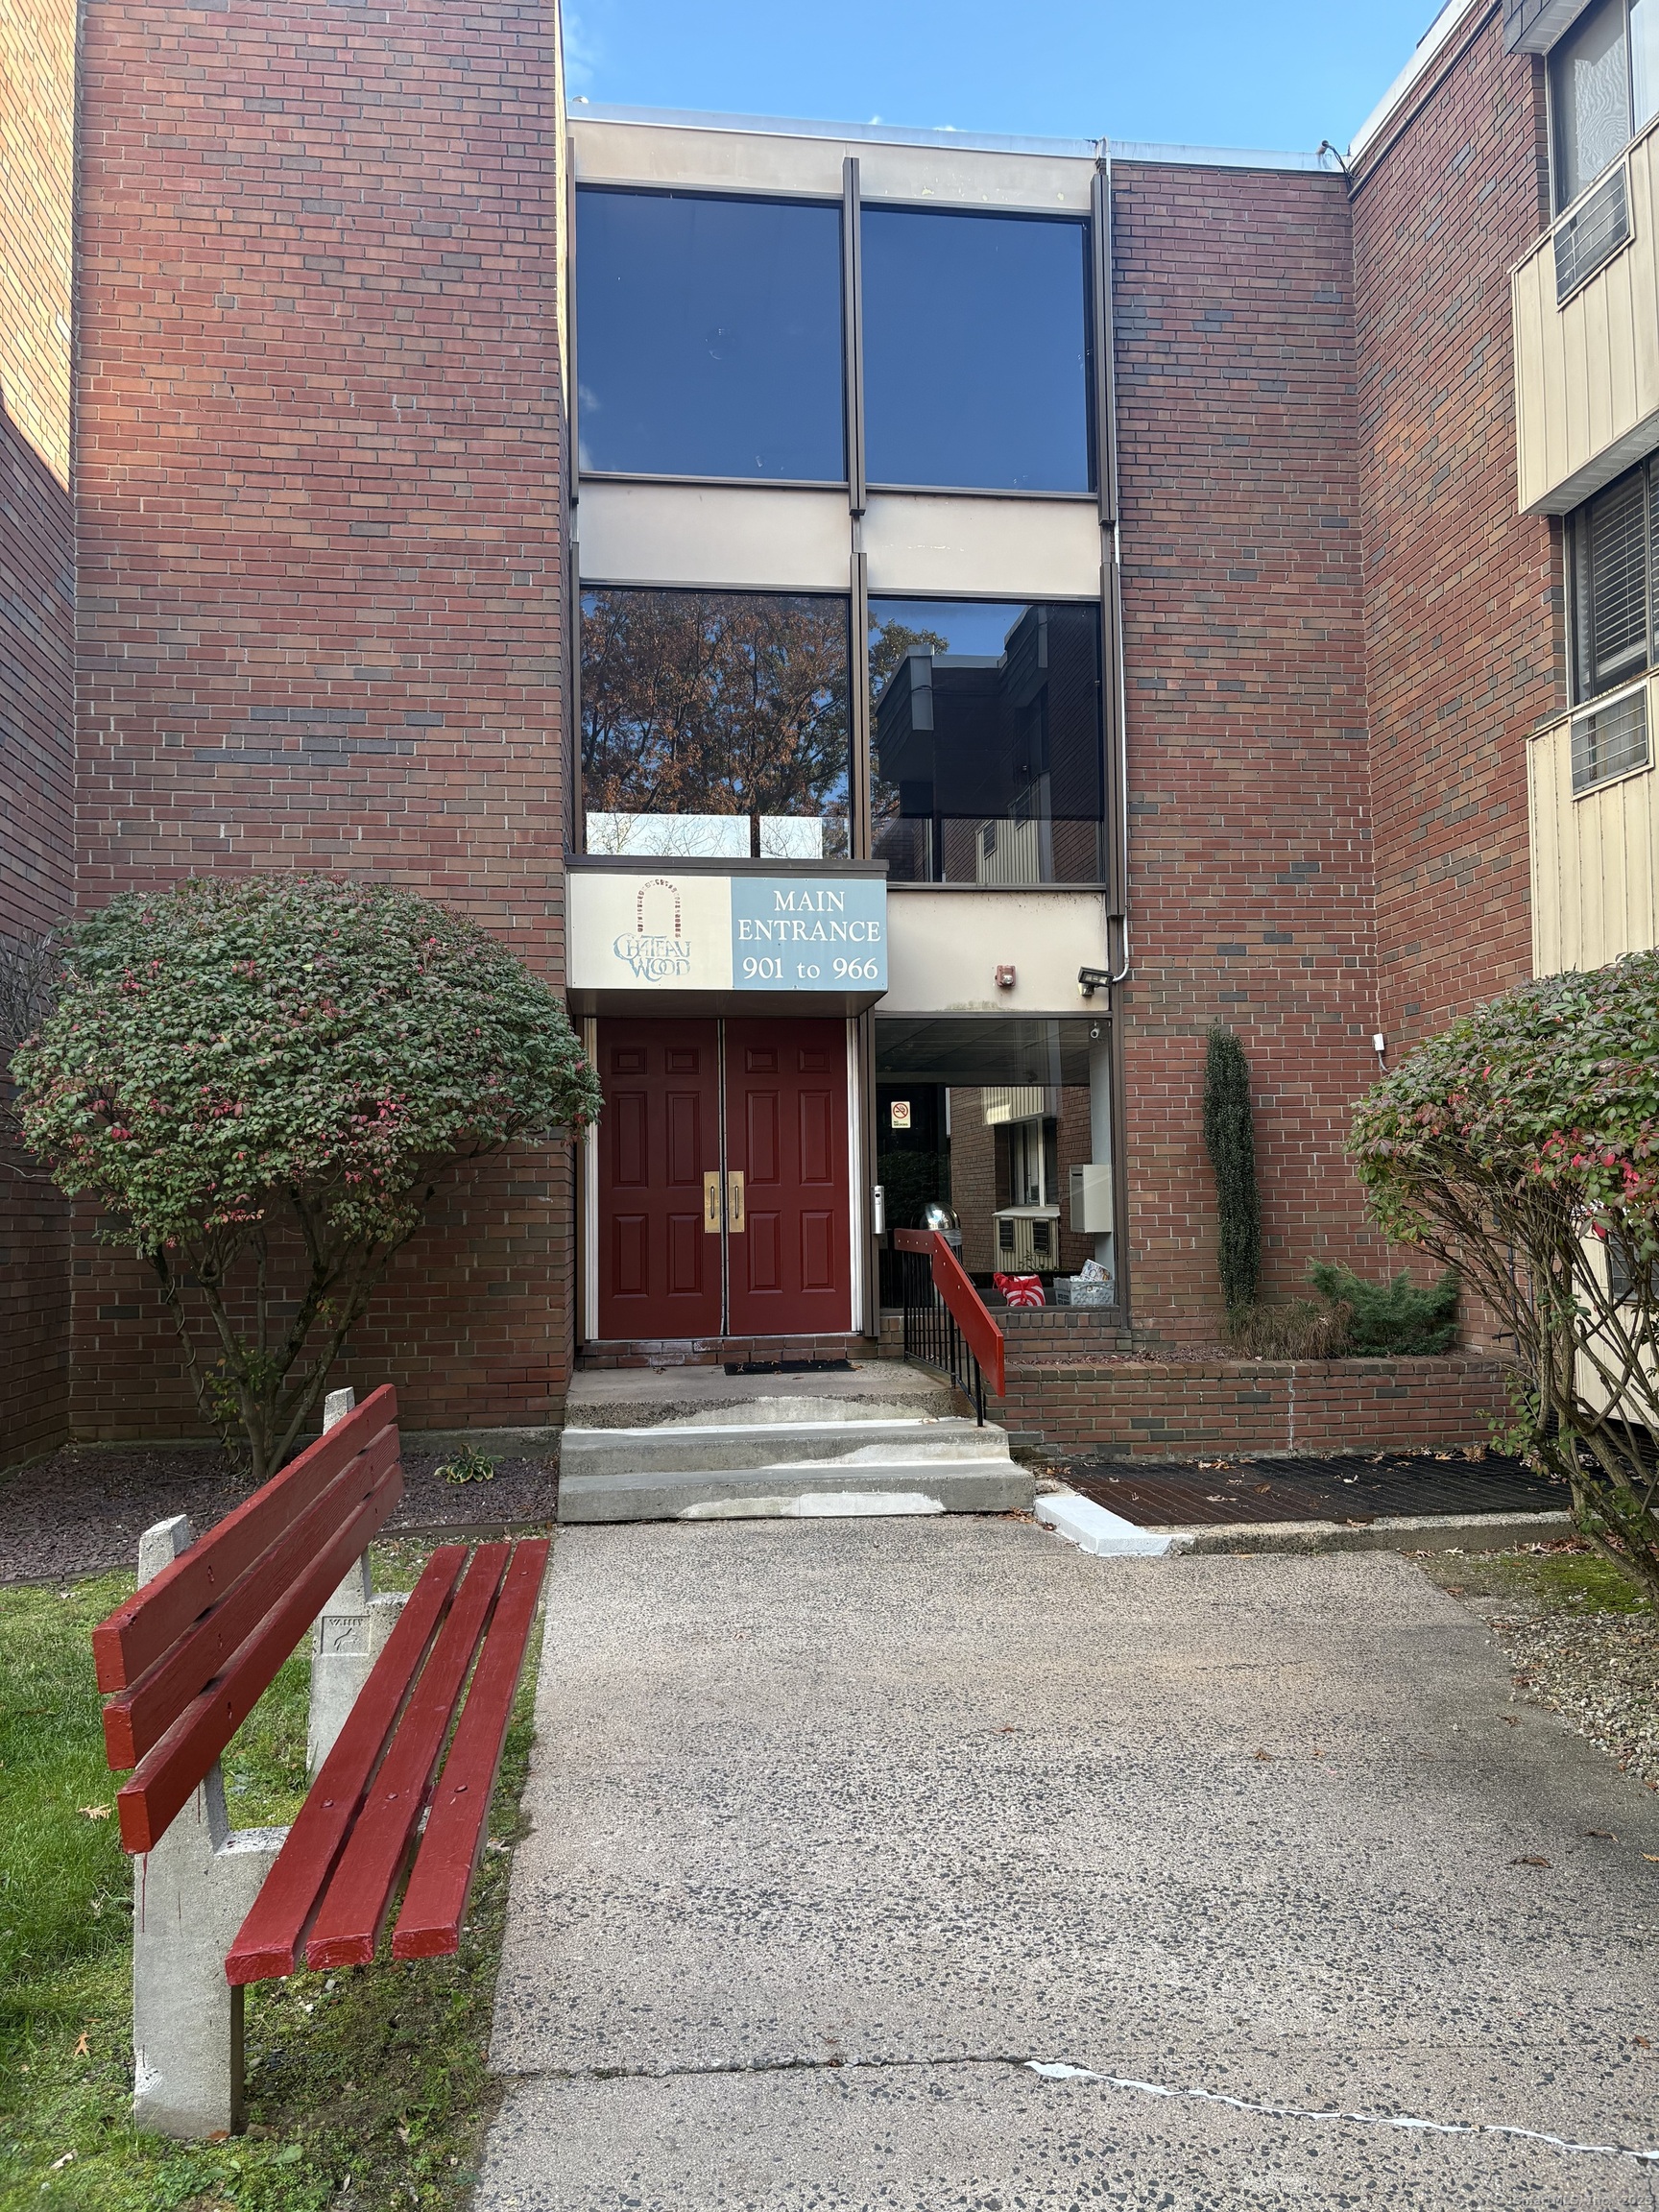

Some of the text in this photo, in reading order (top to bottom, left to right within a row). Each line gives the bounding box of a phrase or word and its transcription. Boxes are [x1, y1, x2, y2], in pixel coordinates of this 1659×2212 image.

[773, 890, 846, 912] MAIN
[737, 919, 881, 942] ENTRANCE
[613, 932, 691, 961] CHATEAU
[628, 957, 690, 982] WOOD
[742, 956, 878, 979] 901 to 966
